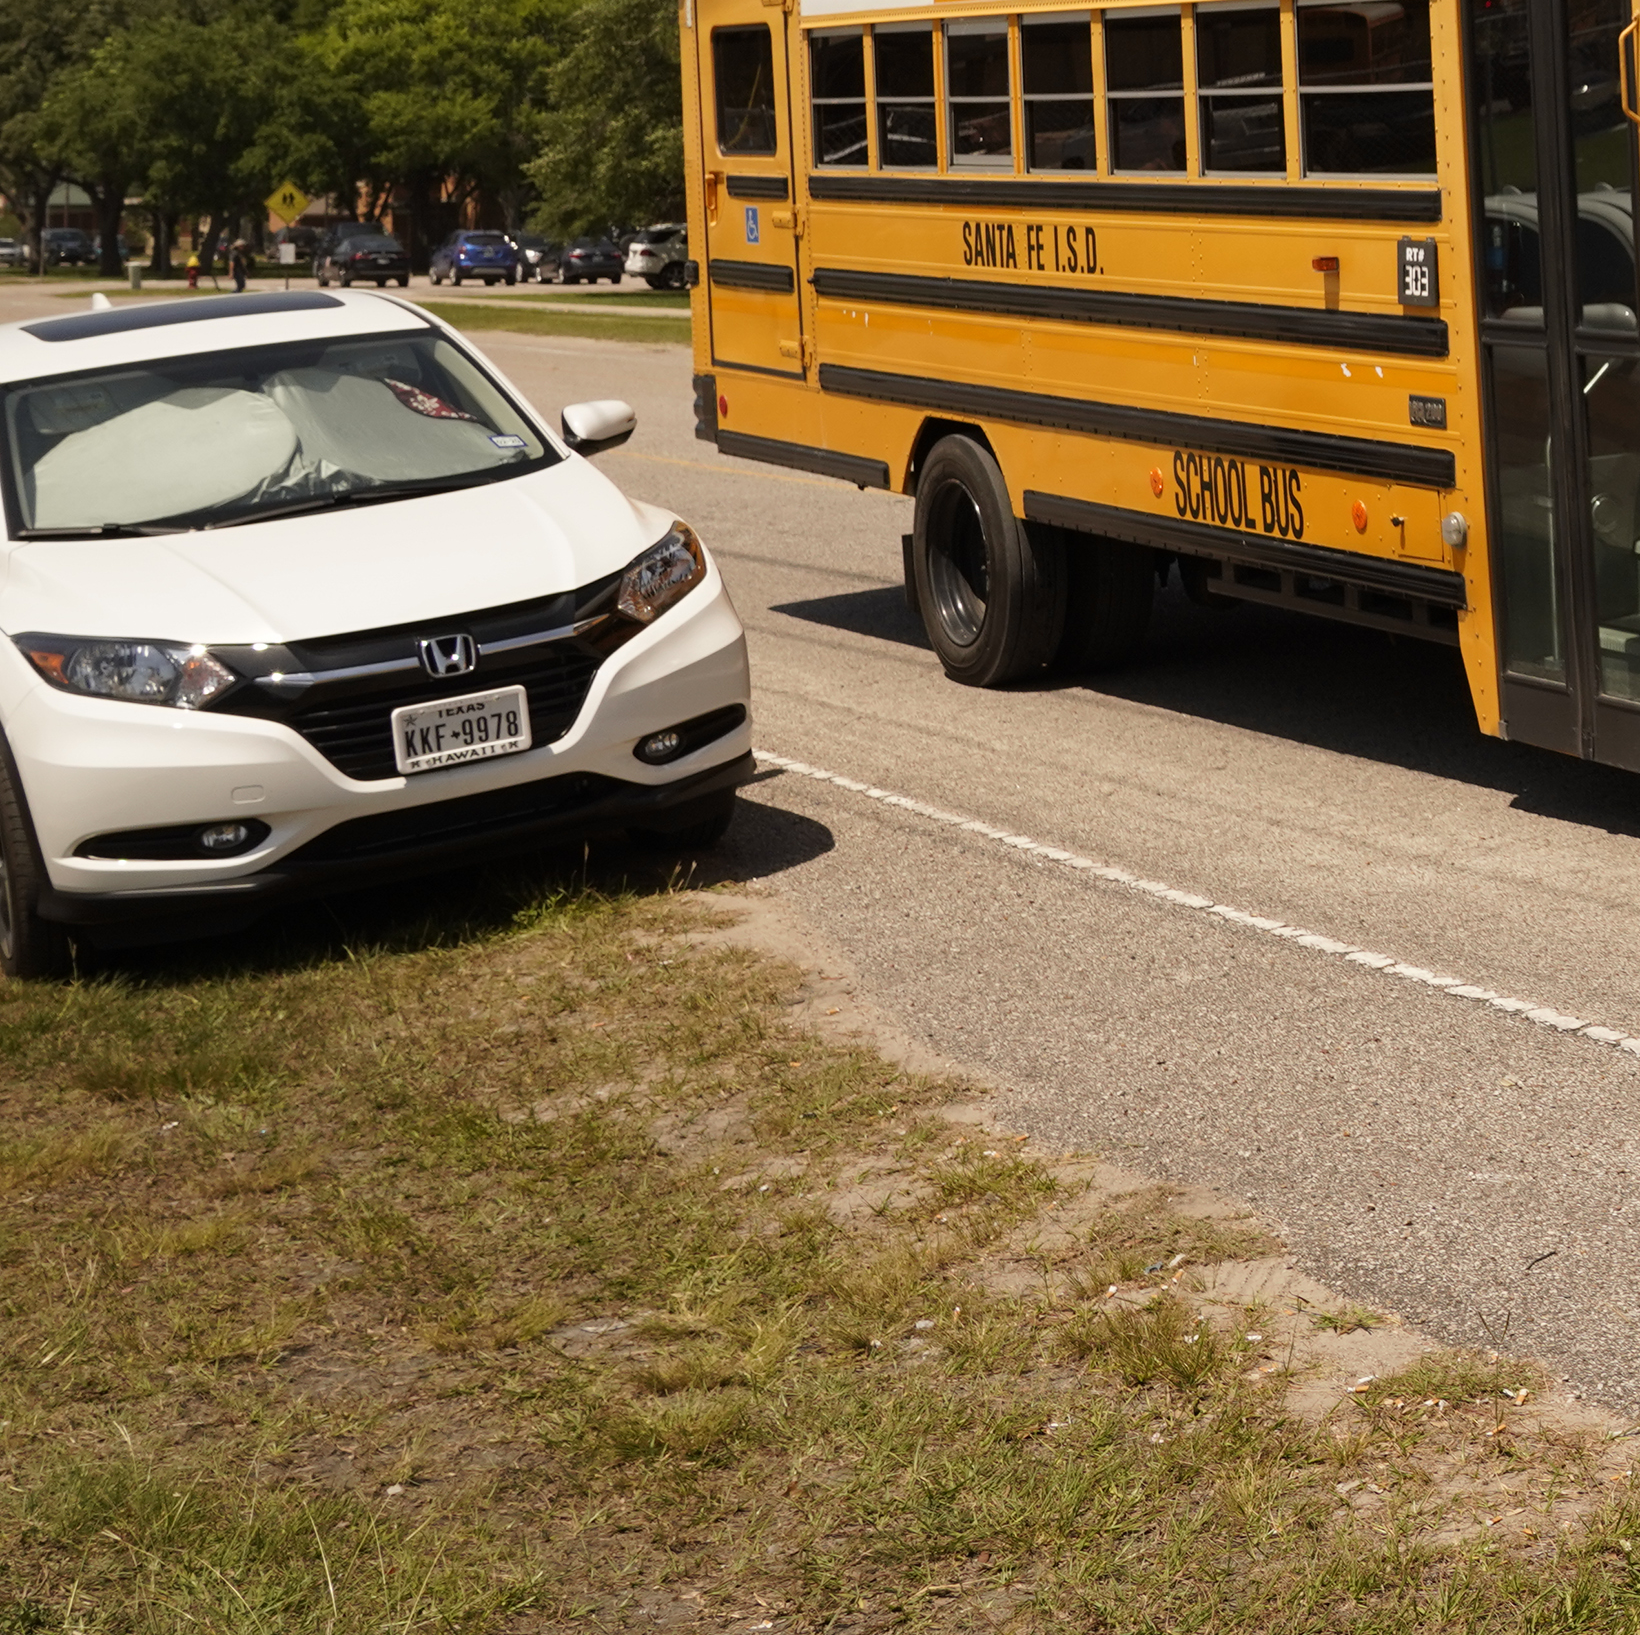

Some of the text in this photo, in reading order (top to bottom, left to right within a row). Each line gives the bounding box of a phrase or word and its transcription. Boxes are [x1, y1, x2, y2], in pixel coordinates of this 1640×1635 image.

[962, 220, 1104, 275] SANTA FE I.S.D.
[1405, 246, 1425, 262] RT#
[1404, 265, 1429, 297] 303
[1174, 450, 1304, 540] SCHOOL BUS
[438, 702, 485, 718] TEXAS
[432, 746, 496, 765] HAWAII
